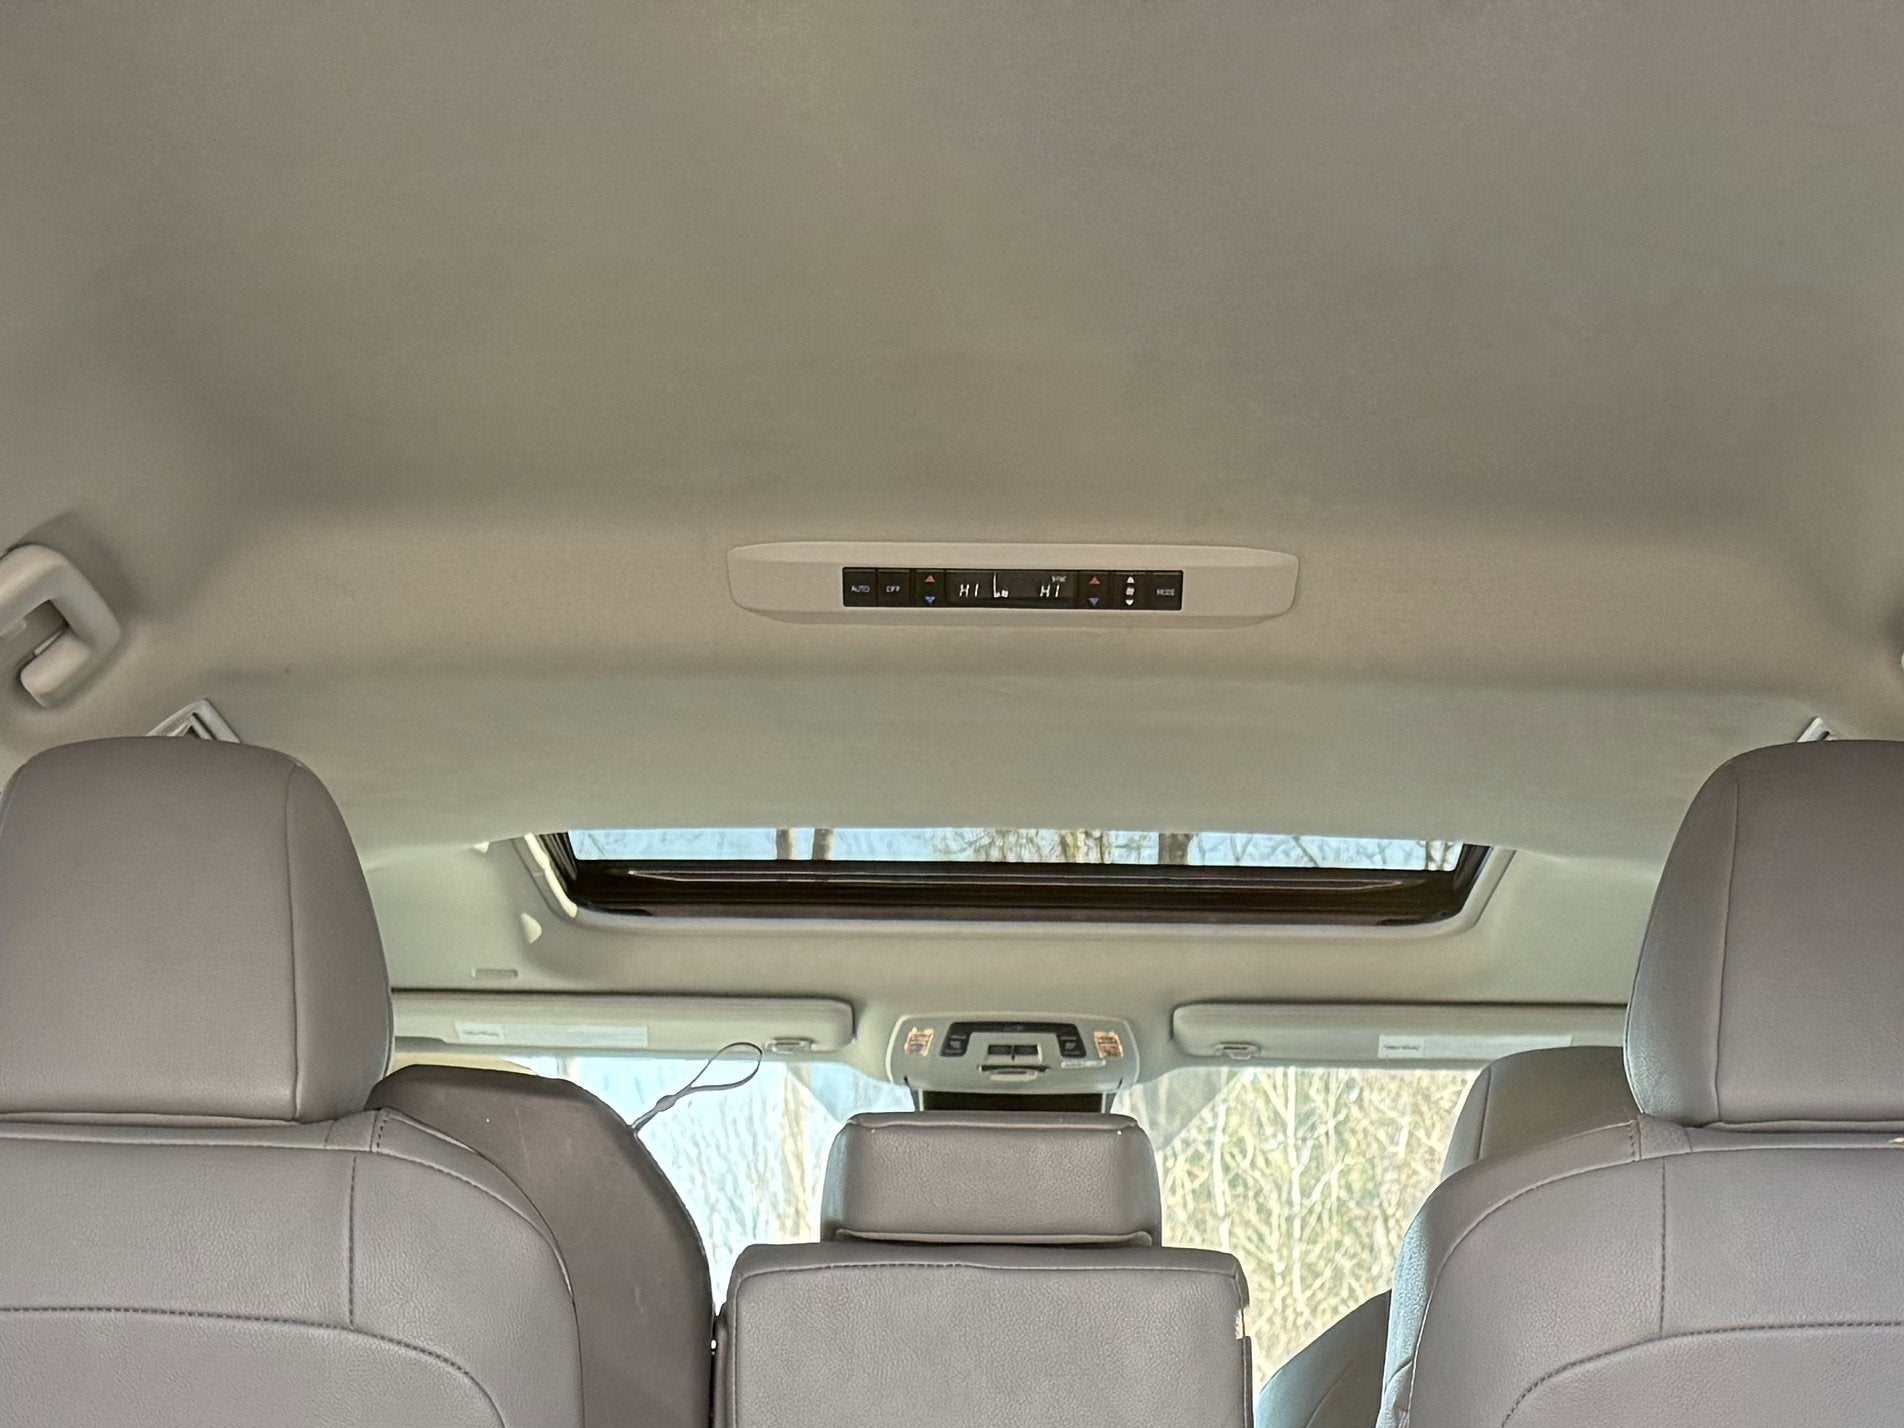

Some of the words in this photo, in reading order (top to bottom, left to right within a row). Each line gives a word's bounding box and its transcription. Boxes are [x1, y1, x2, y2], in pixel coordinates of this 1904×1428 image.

[850, 585, 870, 593] AUTO
[959, 584, 979, 598] HI
[1040, 583, 1060, 598] HI
